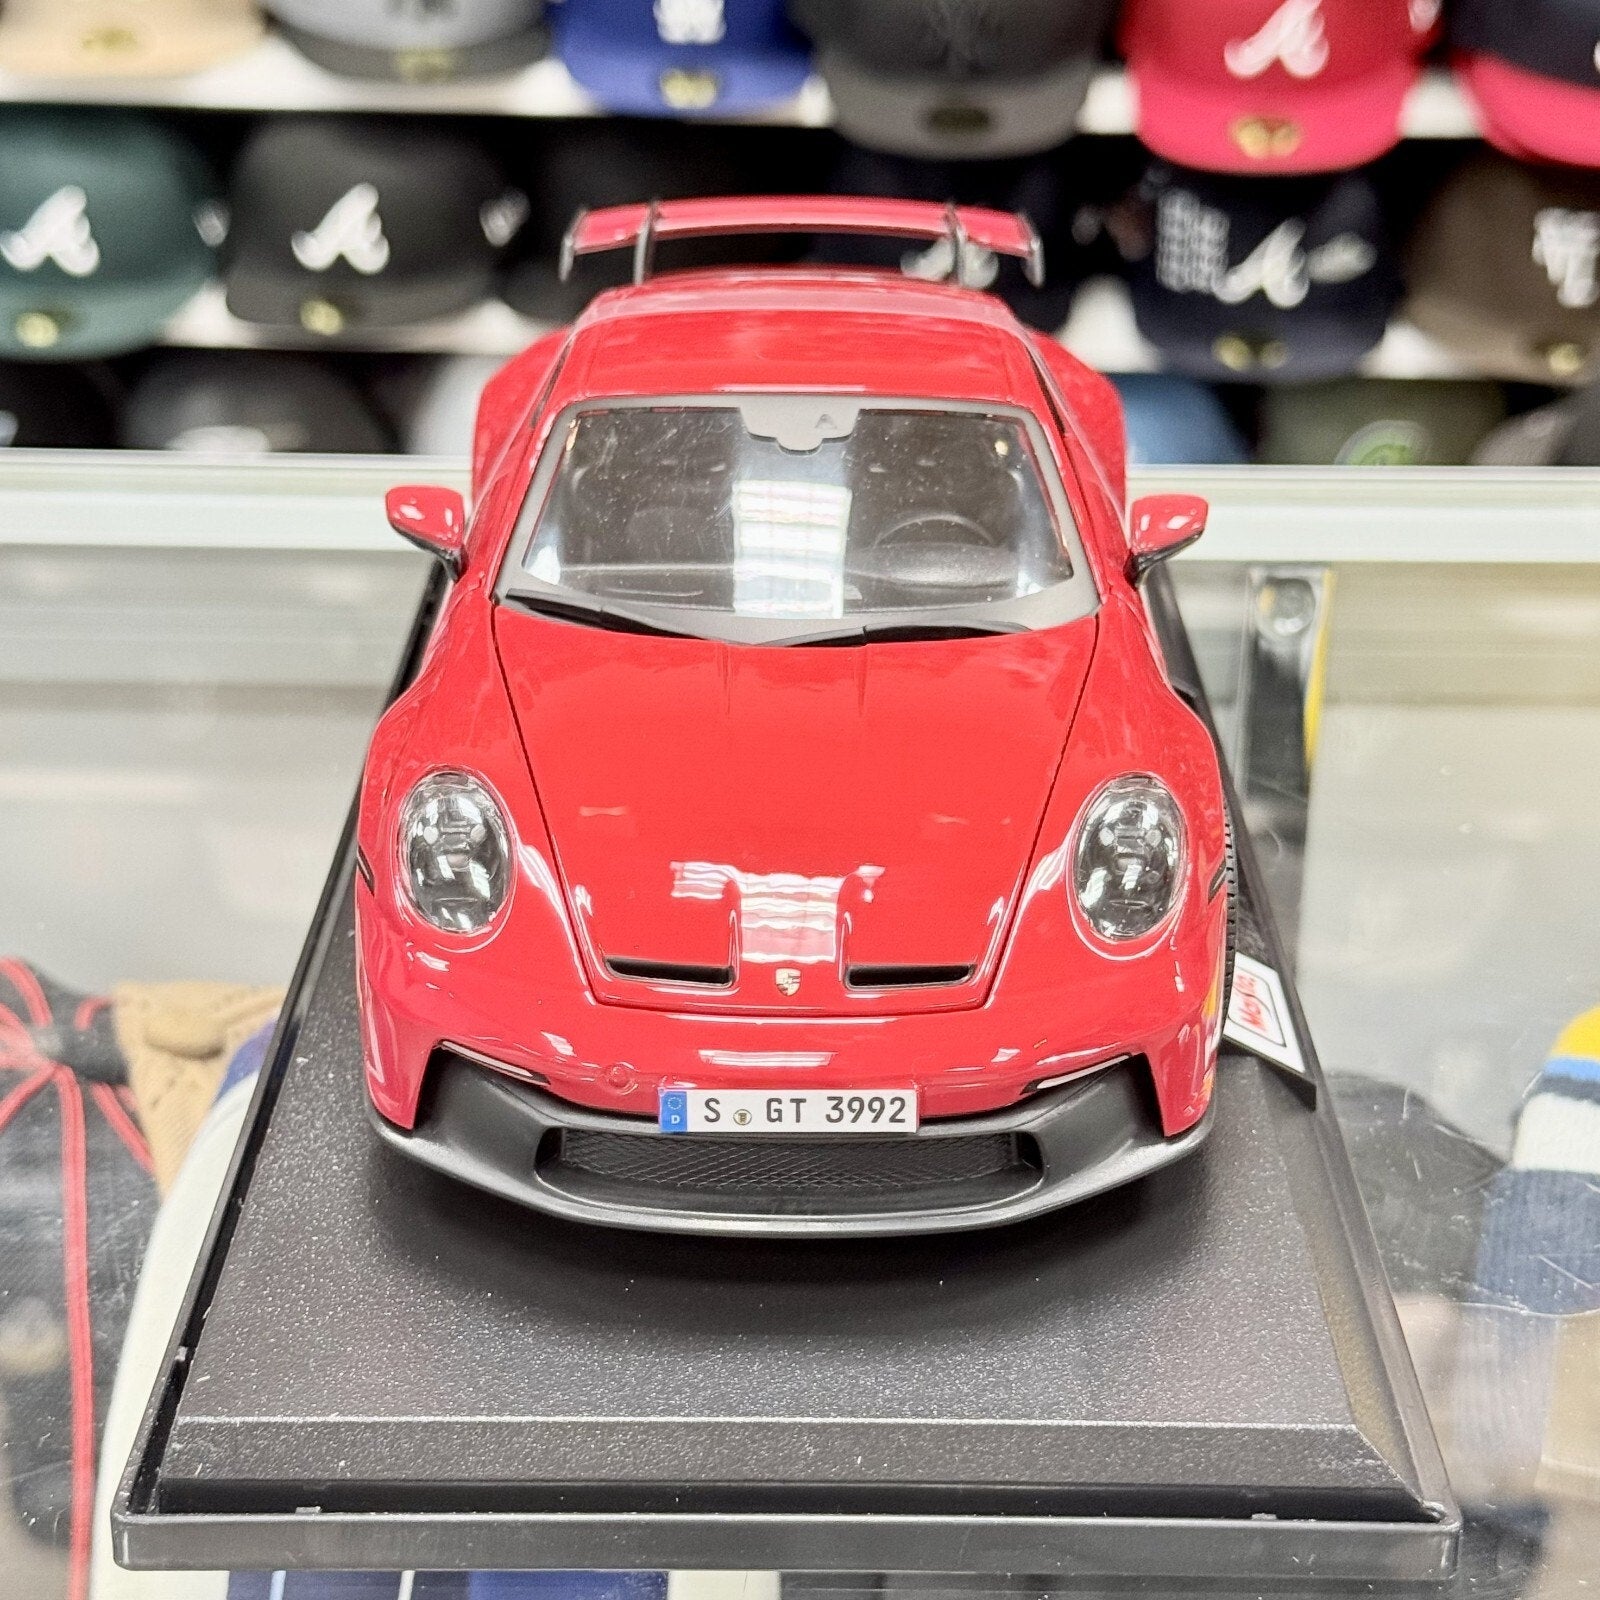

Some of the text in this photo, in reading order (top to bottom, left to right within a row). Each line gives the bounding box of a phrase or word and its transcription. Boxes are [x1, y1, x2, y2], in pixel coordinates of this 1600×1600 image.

[704, 1096, 906, 1124] S GT 3992
[670, 1115, 680, 1125] D
